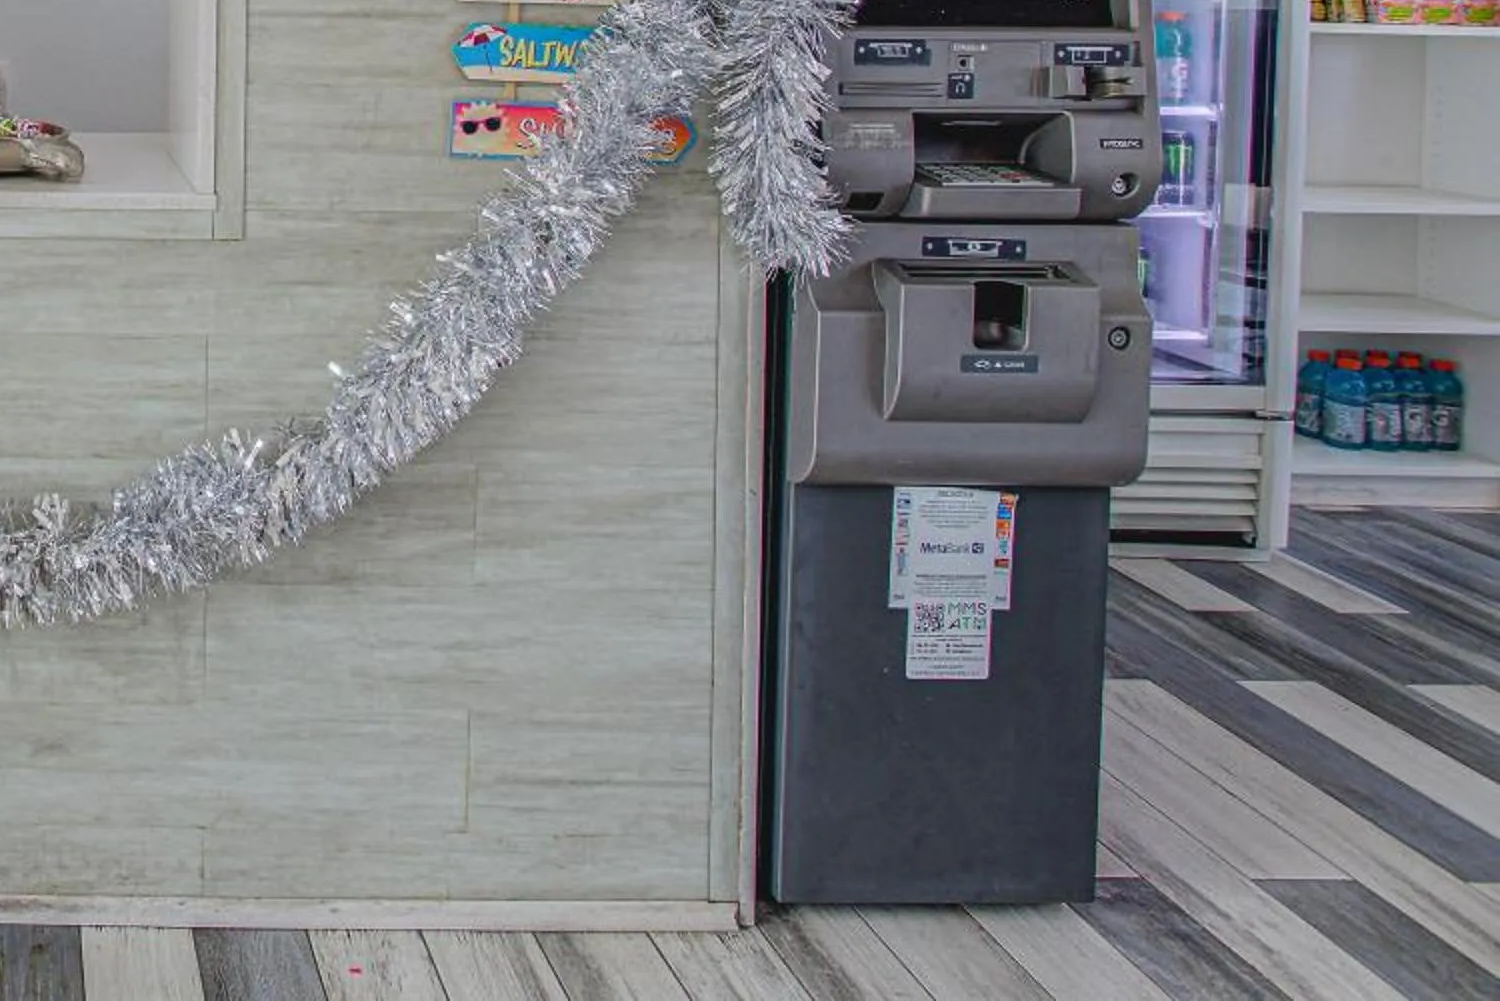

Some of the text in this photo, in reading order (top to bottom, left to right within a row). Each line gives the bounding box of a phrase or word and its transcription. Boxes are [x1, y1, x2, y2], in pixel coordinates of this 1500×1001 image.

[500, 35, 583, 68] SALTW
[919, 542, 971, 554] MetaBank
[947, 616, 987, 630] ATM
